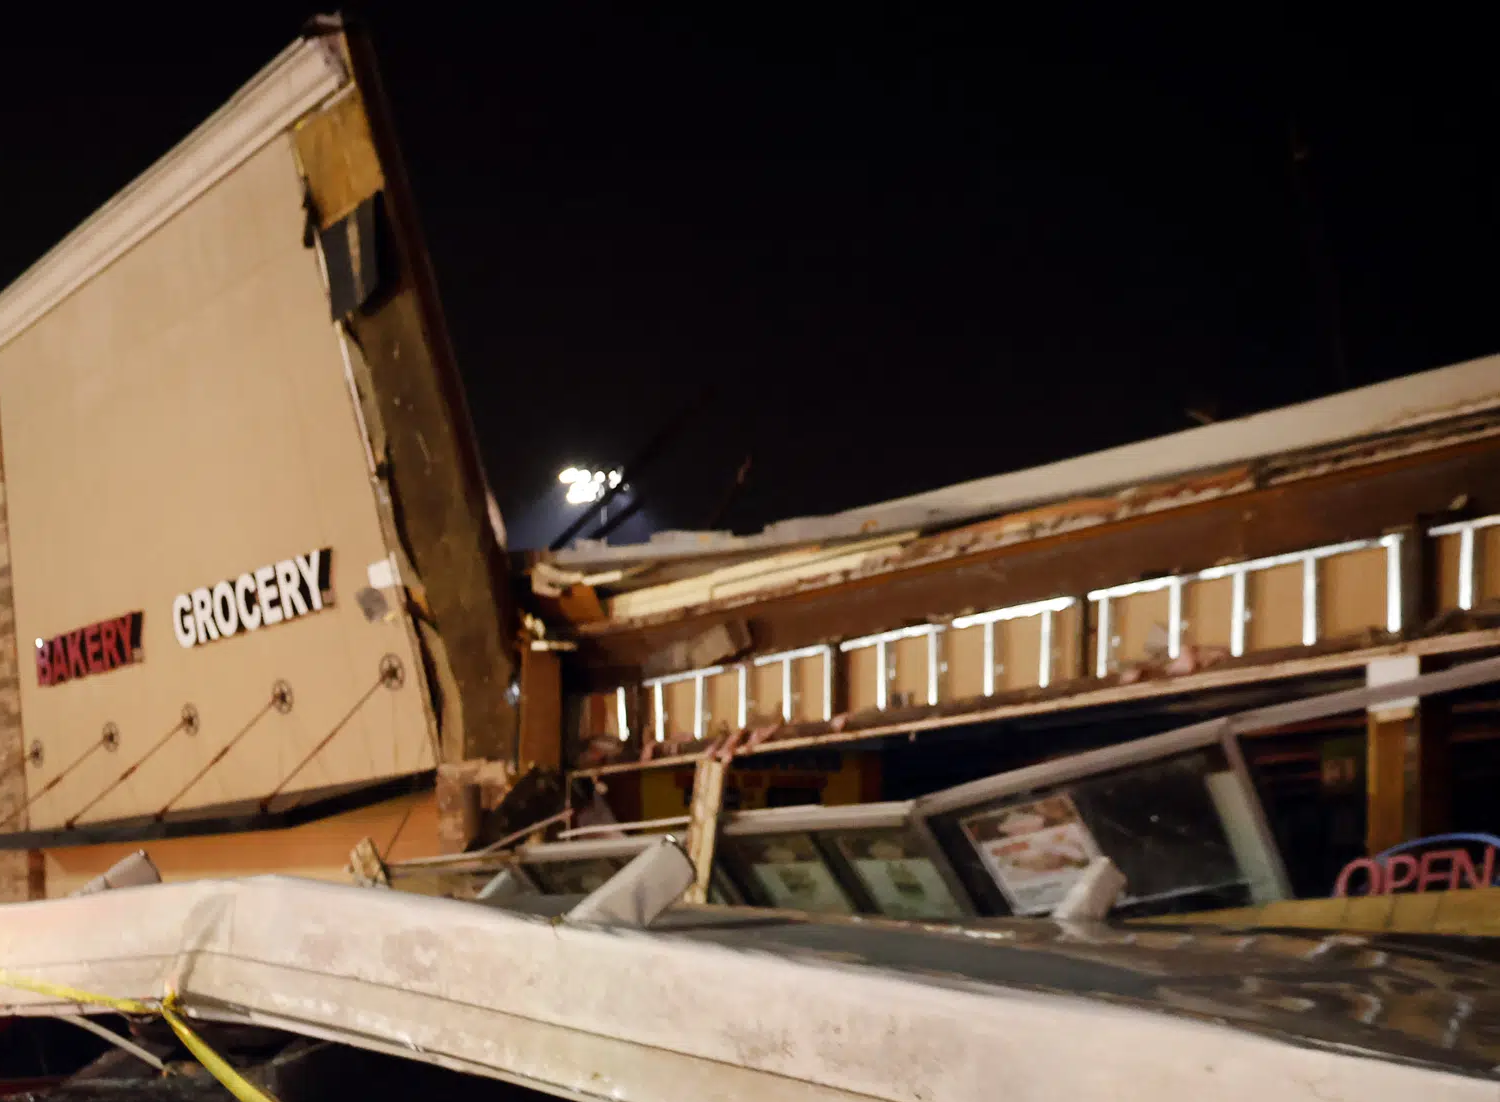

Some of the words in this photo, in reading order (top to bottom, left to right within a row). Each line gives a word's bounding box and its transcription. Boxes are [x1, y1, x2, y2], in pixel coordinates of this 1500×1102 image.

[173, 549, 324, 648] GROCERY
[36, 612, 138, 687] BAKERY
[1331, 845, 1496, 899] OPEN
